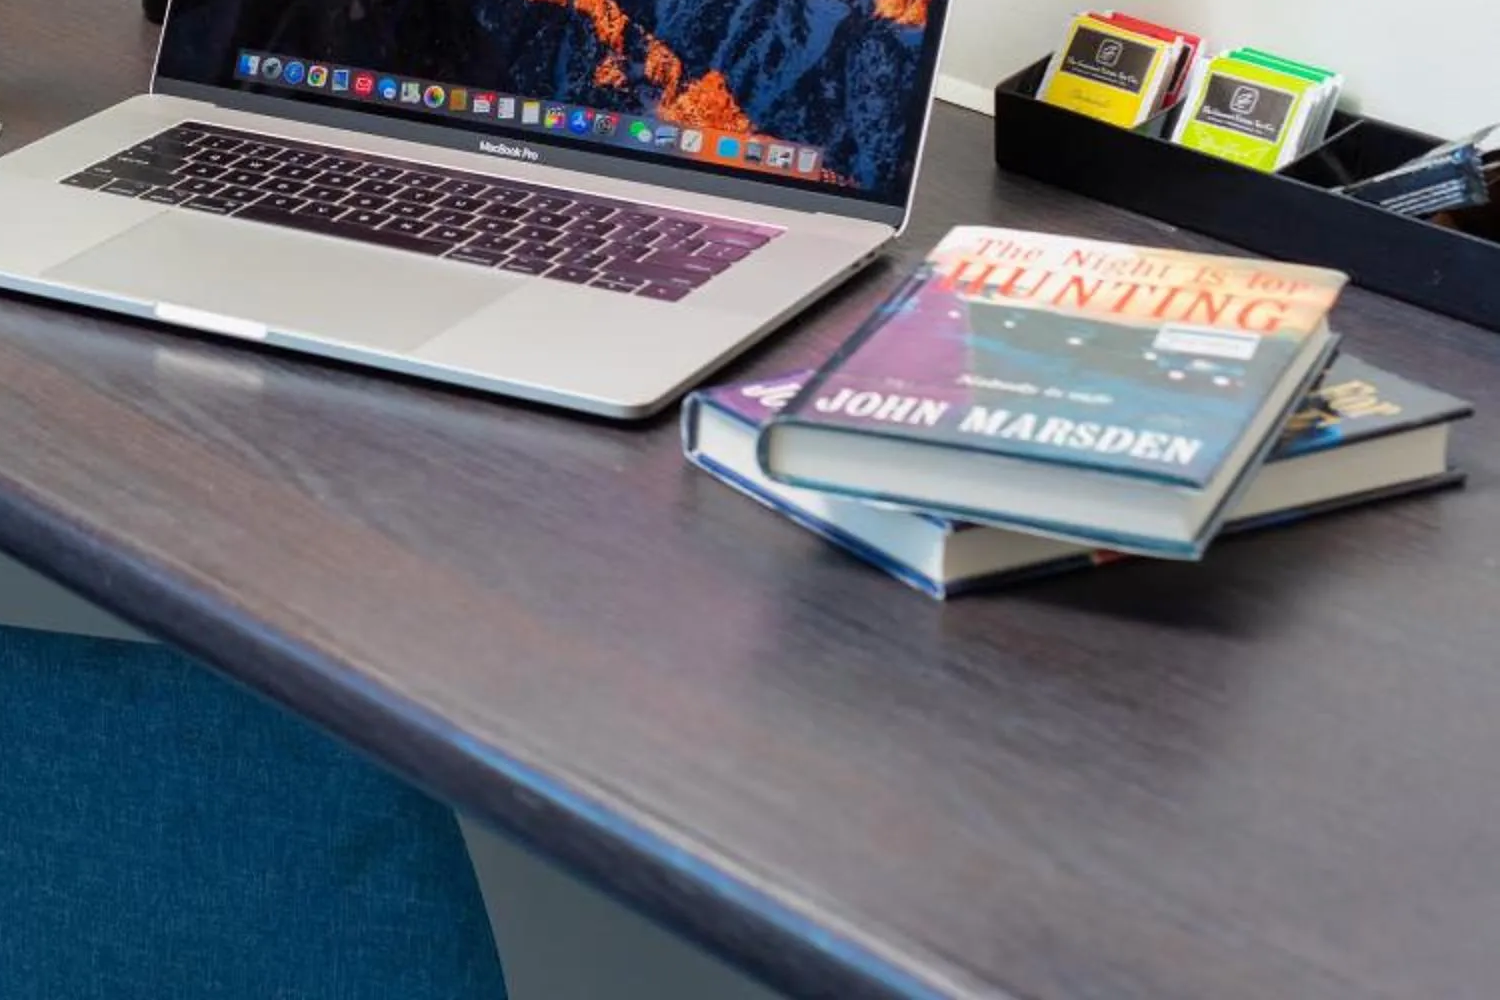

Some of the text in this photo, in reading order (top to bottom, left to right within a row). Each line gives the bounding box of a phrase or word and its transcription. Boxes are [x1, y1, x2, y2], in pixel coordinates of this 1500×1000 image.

[479, 140, 539, 160] MacBook Pro
[940, 259, 1288, 333] HUNTING
[977, 237, 1042, 262] The
[1064, 249, 1173, 281] Night
[1246, 270, 1314, 294] for
[815, 387, 1204, 466] JOHN MARSDEN
